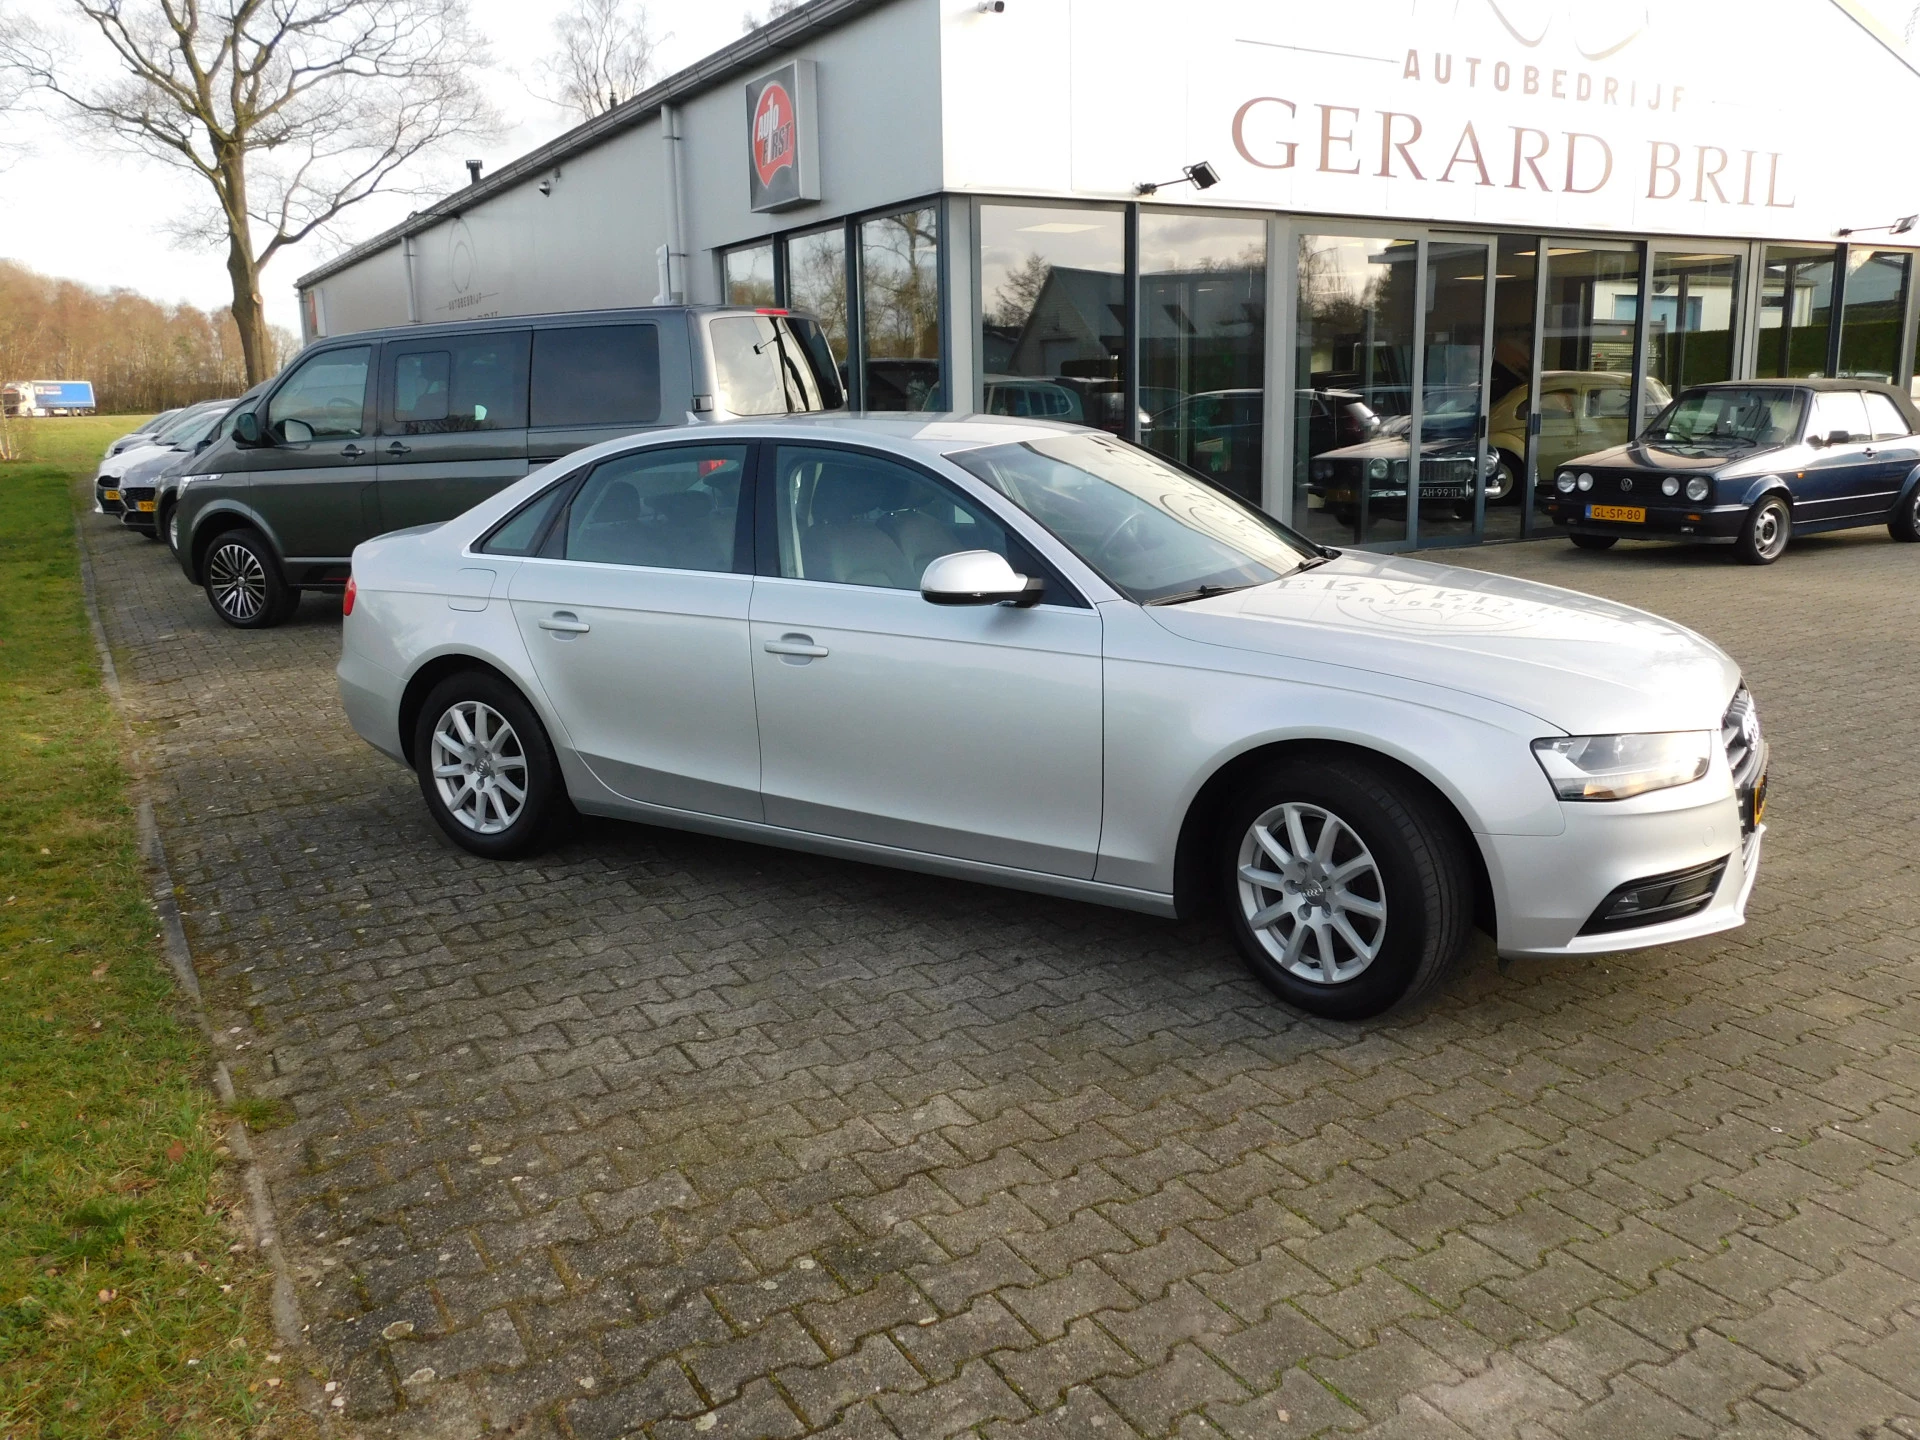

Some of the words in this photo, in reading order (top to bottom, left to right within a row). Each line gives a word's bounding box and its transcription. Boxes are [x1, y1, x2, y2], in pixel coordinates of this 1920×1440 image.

[1402, 48, 1685, 112] AUTOBEDRIJF
[1231, 96, 1614, 195] GERARD
[1645, 140, 1796, 209] BRIL
[1593, 507, 1641, 520] GL-SP-80
